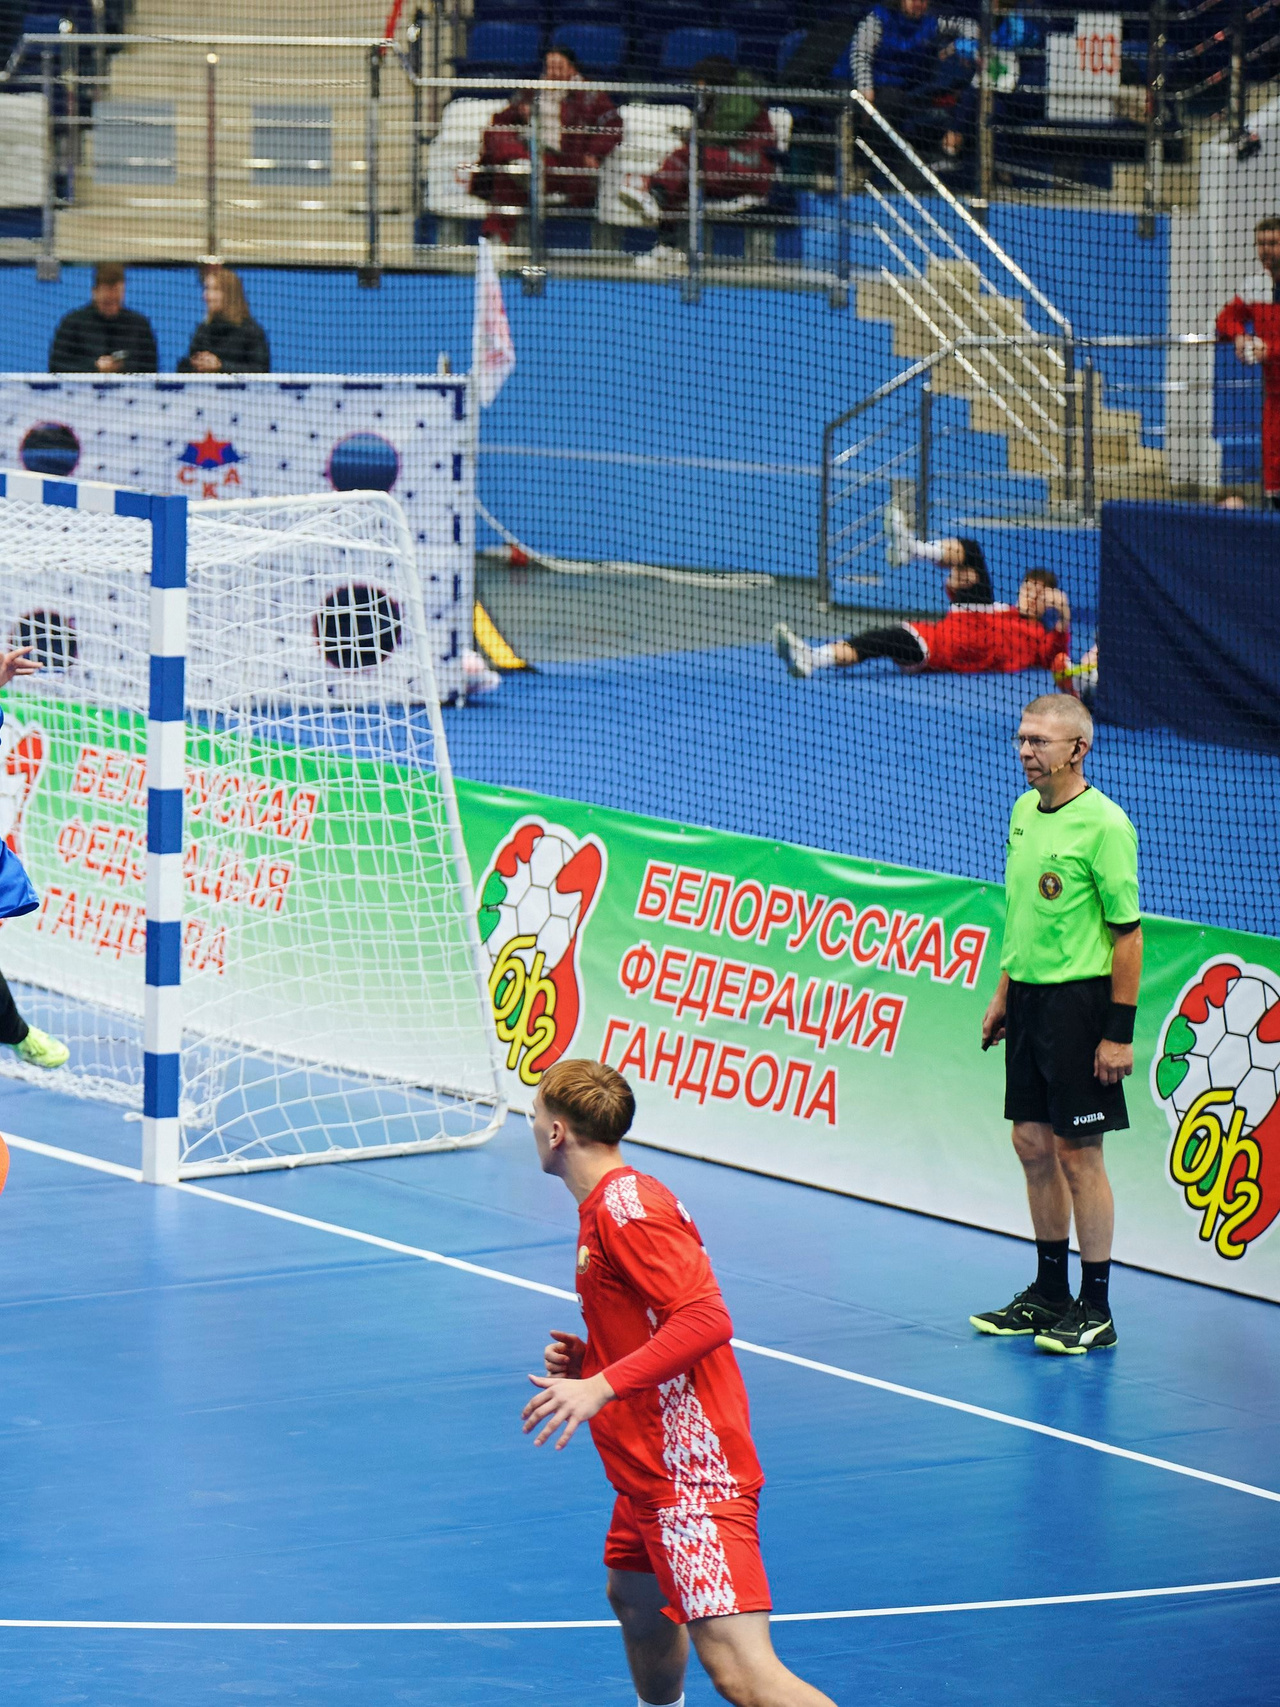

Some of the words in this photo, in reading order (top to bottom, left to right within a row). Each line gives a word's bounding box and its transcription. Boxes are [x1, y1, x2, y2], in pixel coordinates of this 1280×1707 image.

[36, 886, 225, 975] ГАНДБЛА
[638, 865, 987, 985] БЕЛОРУССКАЯ
[621, 944, 905, 1054] ФЕДЕРАЦИЯ
[600, 1020, 838, 1126] ГАНДБОЛА
